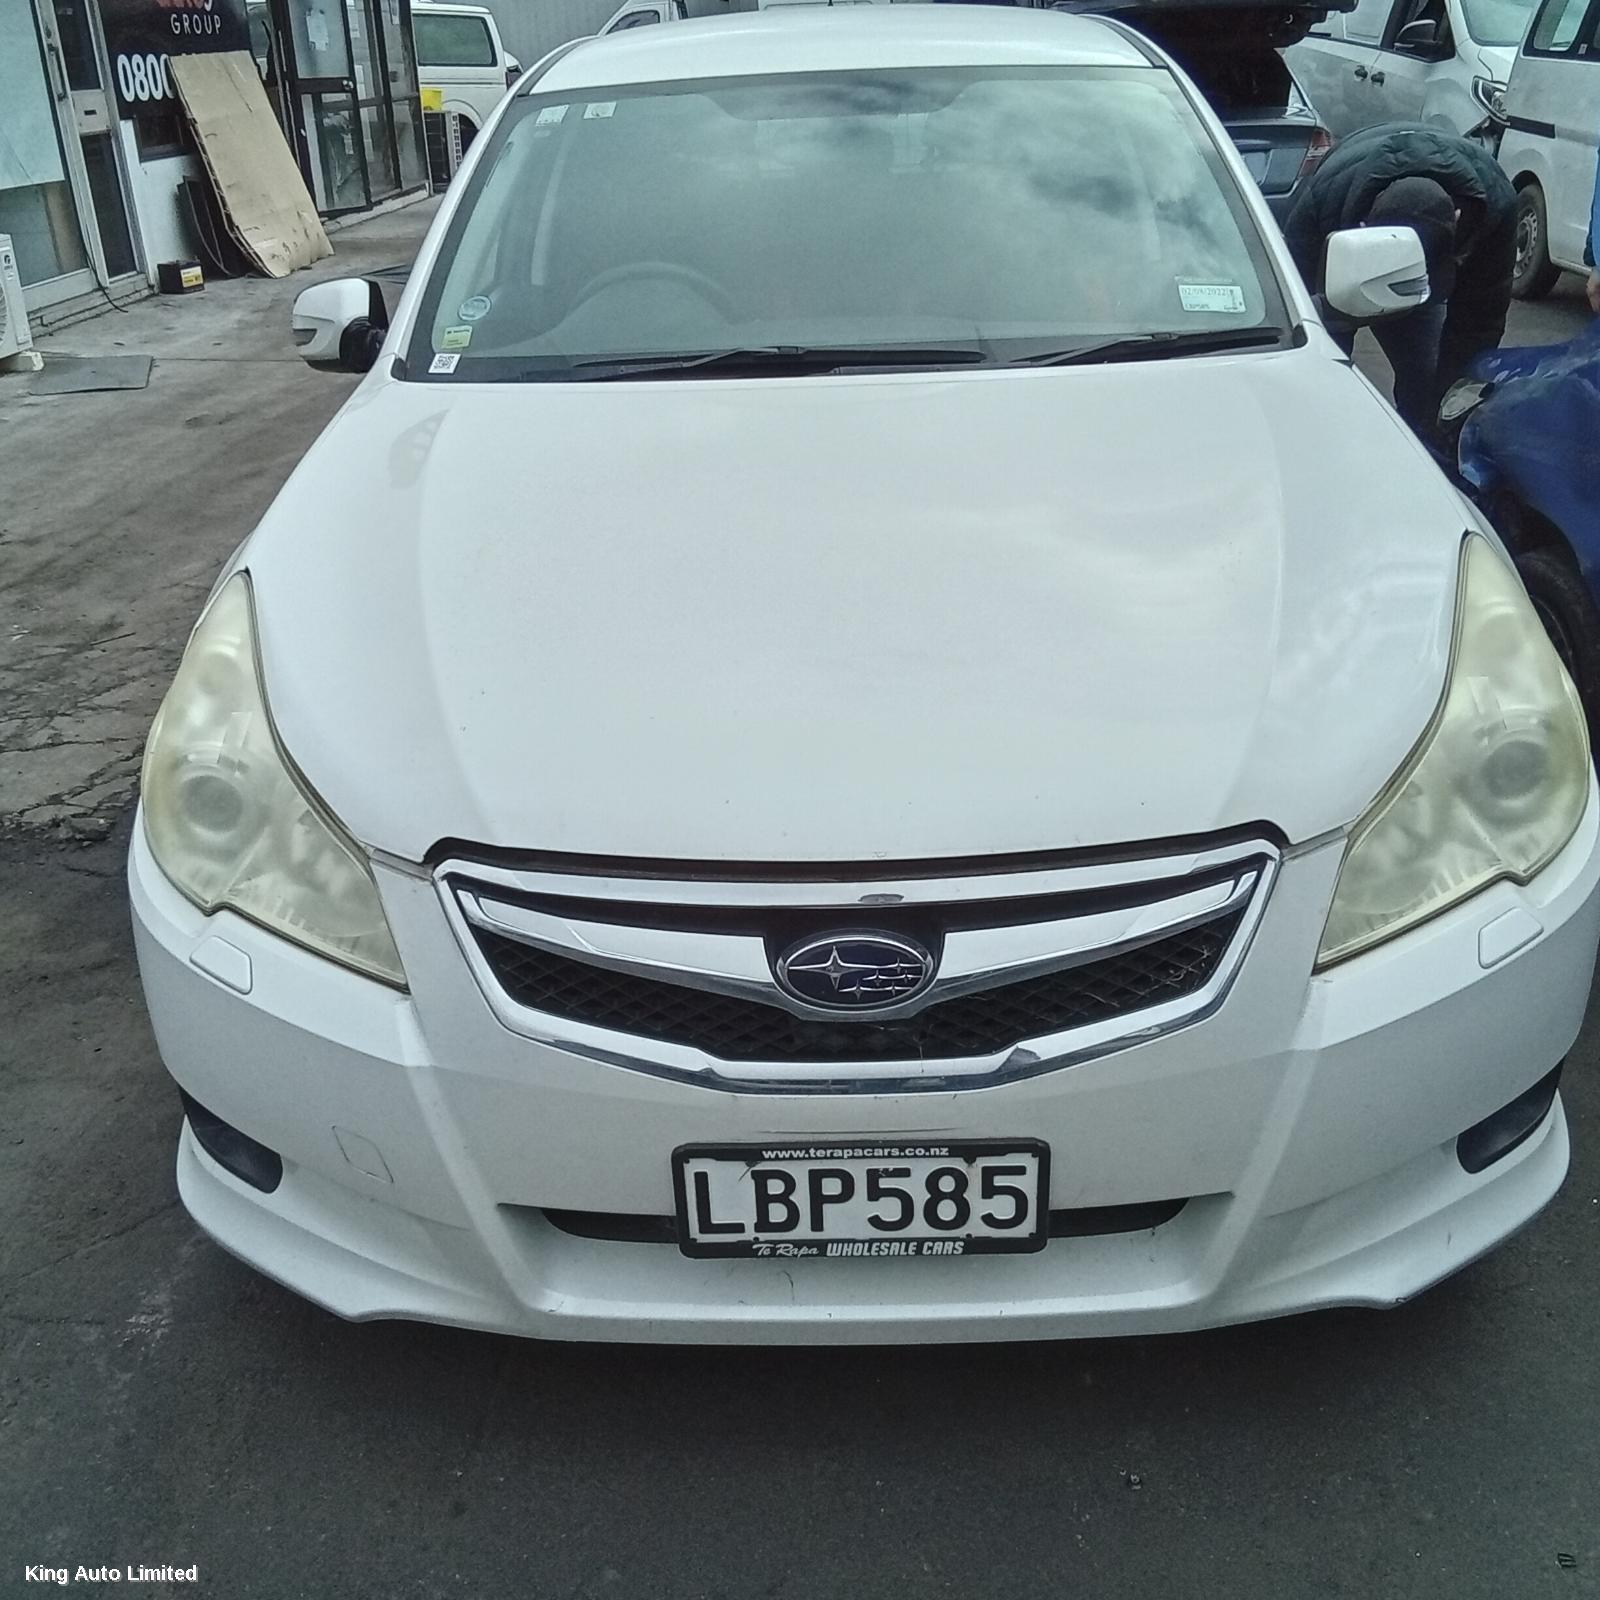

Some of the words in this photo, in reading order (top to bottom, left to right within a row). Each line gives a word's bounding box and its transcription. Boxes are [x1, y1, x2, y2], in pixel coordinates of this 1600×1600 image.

[170, 13, 221, 35] GROUP
[762, 1146, 950, 1160] www.terapacars.co.nz
[693, 1164, 1029, 1235] LBP585
[752, 1243, 771, 1257] Te
[775, 1243, 819, 1258] Rapa
[826, 1241, 918, 1257] WHOLESALE
[922, 1241, 965, 1256] CARS
